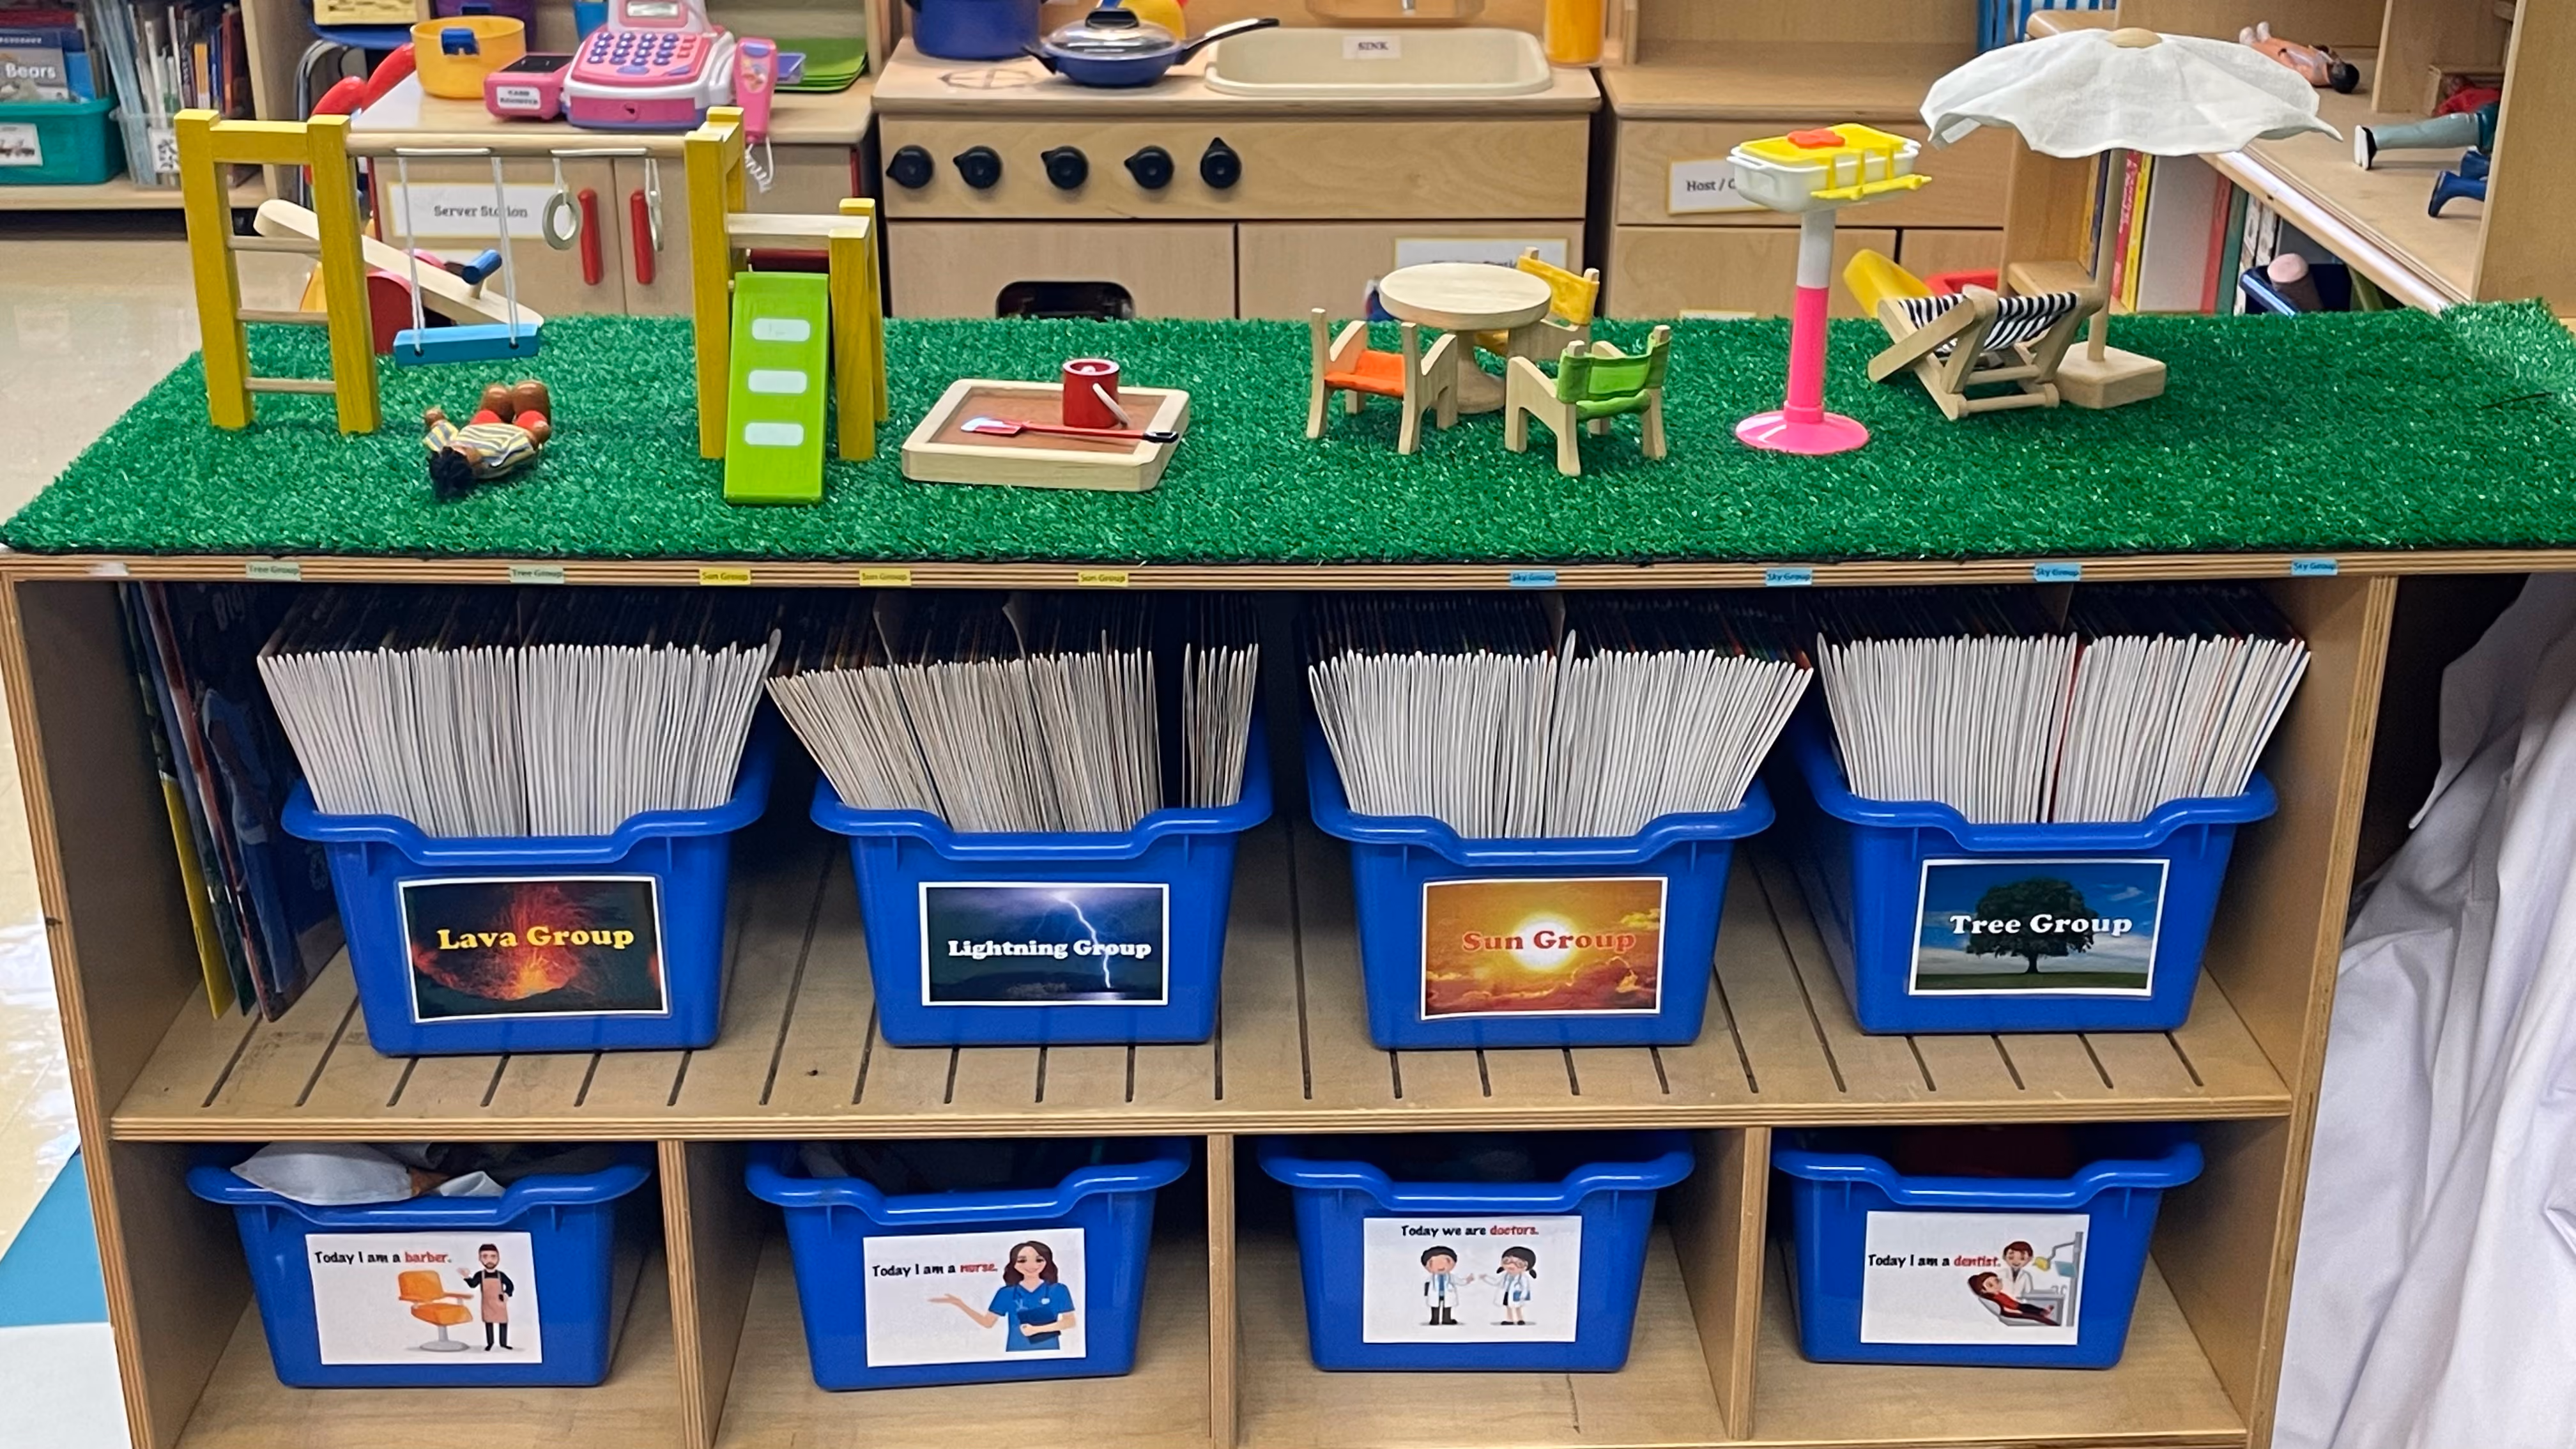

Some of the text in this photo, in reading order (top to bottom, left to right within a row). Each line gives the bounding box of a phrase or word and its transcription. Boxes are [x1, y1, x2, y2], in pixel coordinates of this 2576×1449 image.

[1358, 42, 1389, 50] SINK
[6, 62, 56, 79] Bears
[1686, 180, 1717, 192] Host
[434, 205, 528, 218] Server Staion
[270, 565, 299, 576] Group
[534, 569, 562, 578] Group
[720, 572, 748, 581] Group
[880, 572, 907, 581] Group
[1784, 572, 1811, 581] Group
[2051, 569, 2079, 578] Group
[1098, 574, 1126, 583] Group
[1528, 573, 1555, 581] Group
[1949, 913, 2133, 937] Tree Group
[436, 925, 634, 950] Lava Group
[1462, 930, 1636, 952] Sun Group
[947, 939, 1152, 960] Lightning Group
[1401, 1225, 1539, 1237] Today we are doctors.
[315, 1250, 452, 1264] Today I am a barber.
[1868, 1254, 2002, 1268] Today I am a dentist.
[872, 1262, 998, 1277] Today I am a nurse.
